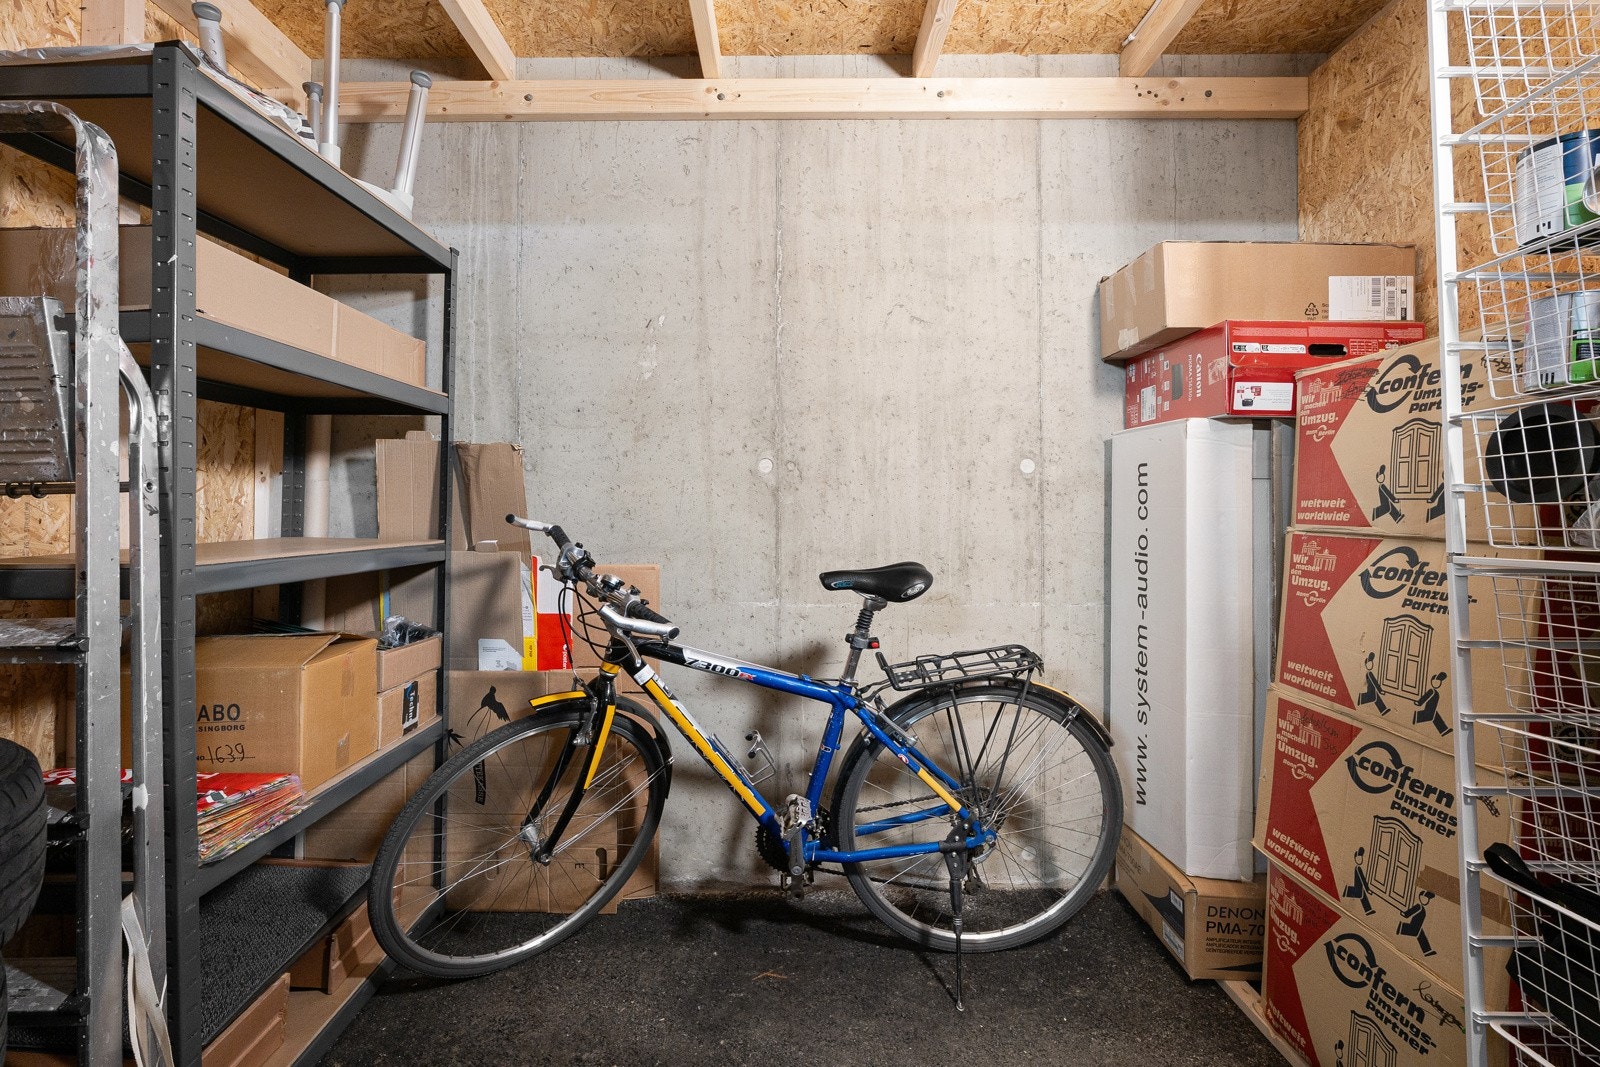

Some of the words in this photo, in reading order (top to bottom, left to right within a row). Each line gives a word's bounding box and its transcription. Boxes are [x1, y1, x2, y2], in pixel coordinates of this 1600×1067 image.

[1377, 363, 1473, 394] confen
[1301, 394, 1315, 404] Wir
[1301, 412, 1338, 426] Umzug.
[1300, 498, 1346, 508] weltweit
[1297, 511, 1350, 522] worldwide
[1293, 554, 1308, 564] Wir
[1295, 564, 1320, 572] machen
[1372, 562, 1447, 586] confer
[1291, 575, 1330, 592] Umzug.
[1401, 598, 1449, 615] Partn
[685, 657, 740, 677] 7300
[1287, 660, 1334, 682] weltweit
[1283, 672, 1337, 697] worldwide
[1278, 718, 1294, 732] Wir
[1276, 733, 1288, 743] den
[1281, 730, 1306, 745] machen
[207, 743, 245, 764] 1639
[1278, 740, 1318, 768] Umzug.
[1358, 754, 1455, 808] confern
[1272, 828, 1320, 865] weltweit
[1267, 838, 1322, 881] worldwide
[1207, 905, 1265, 920] DENON
[1336, 945, 1425, 1024] confern
